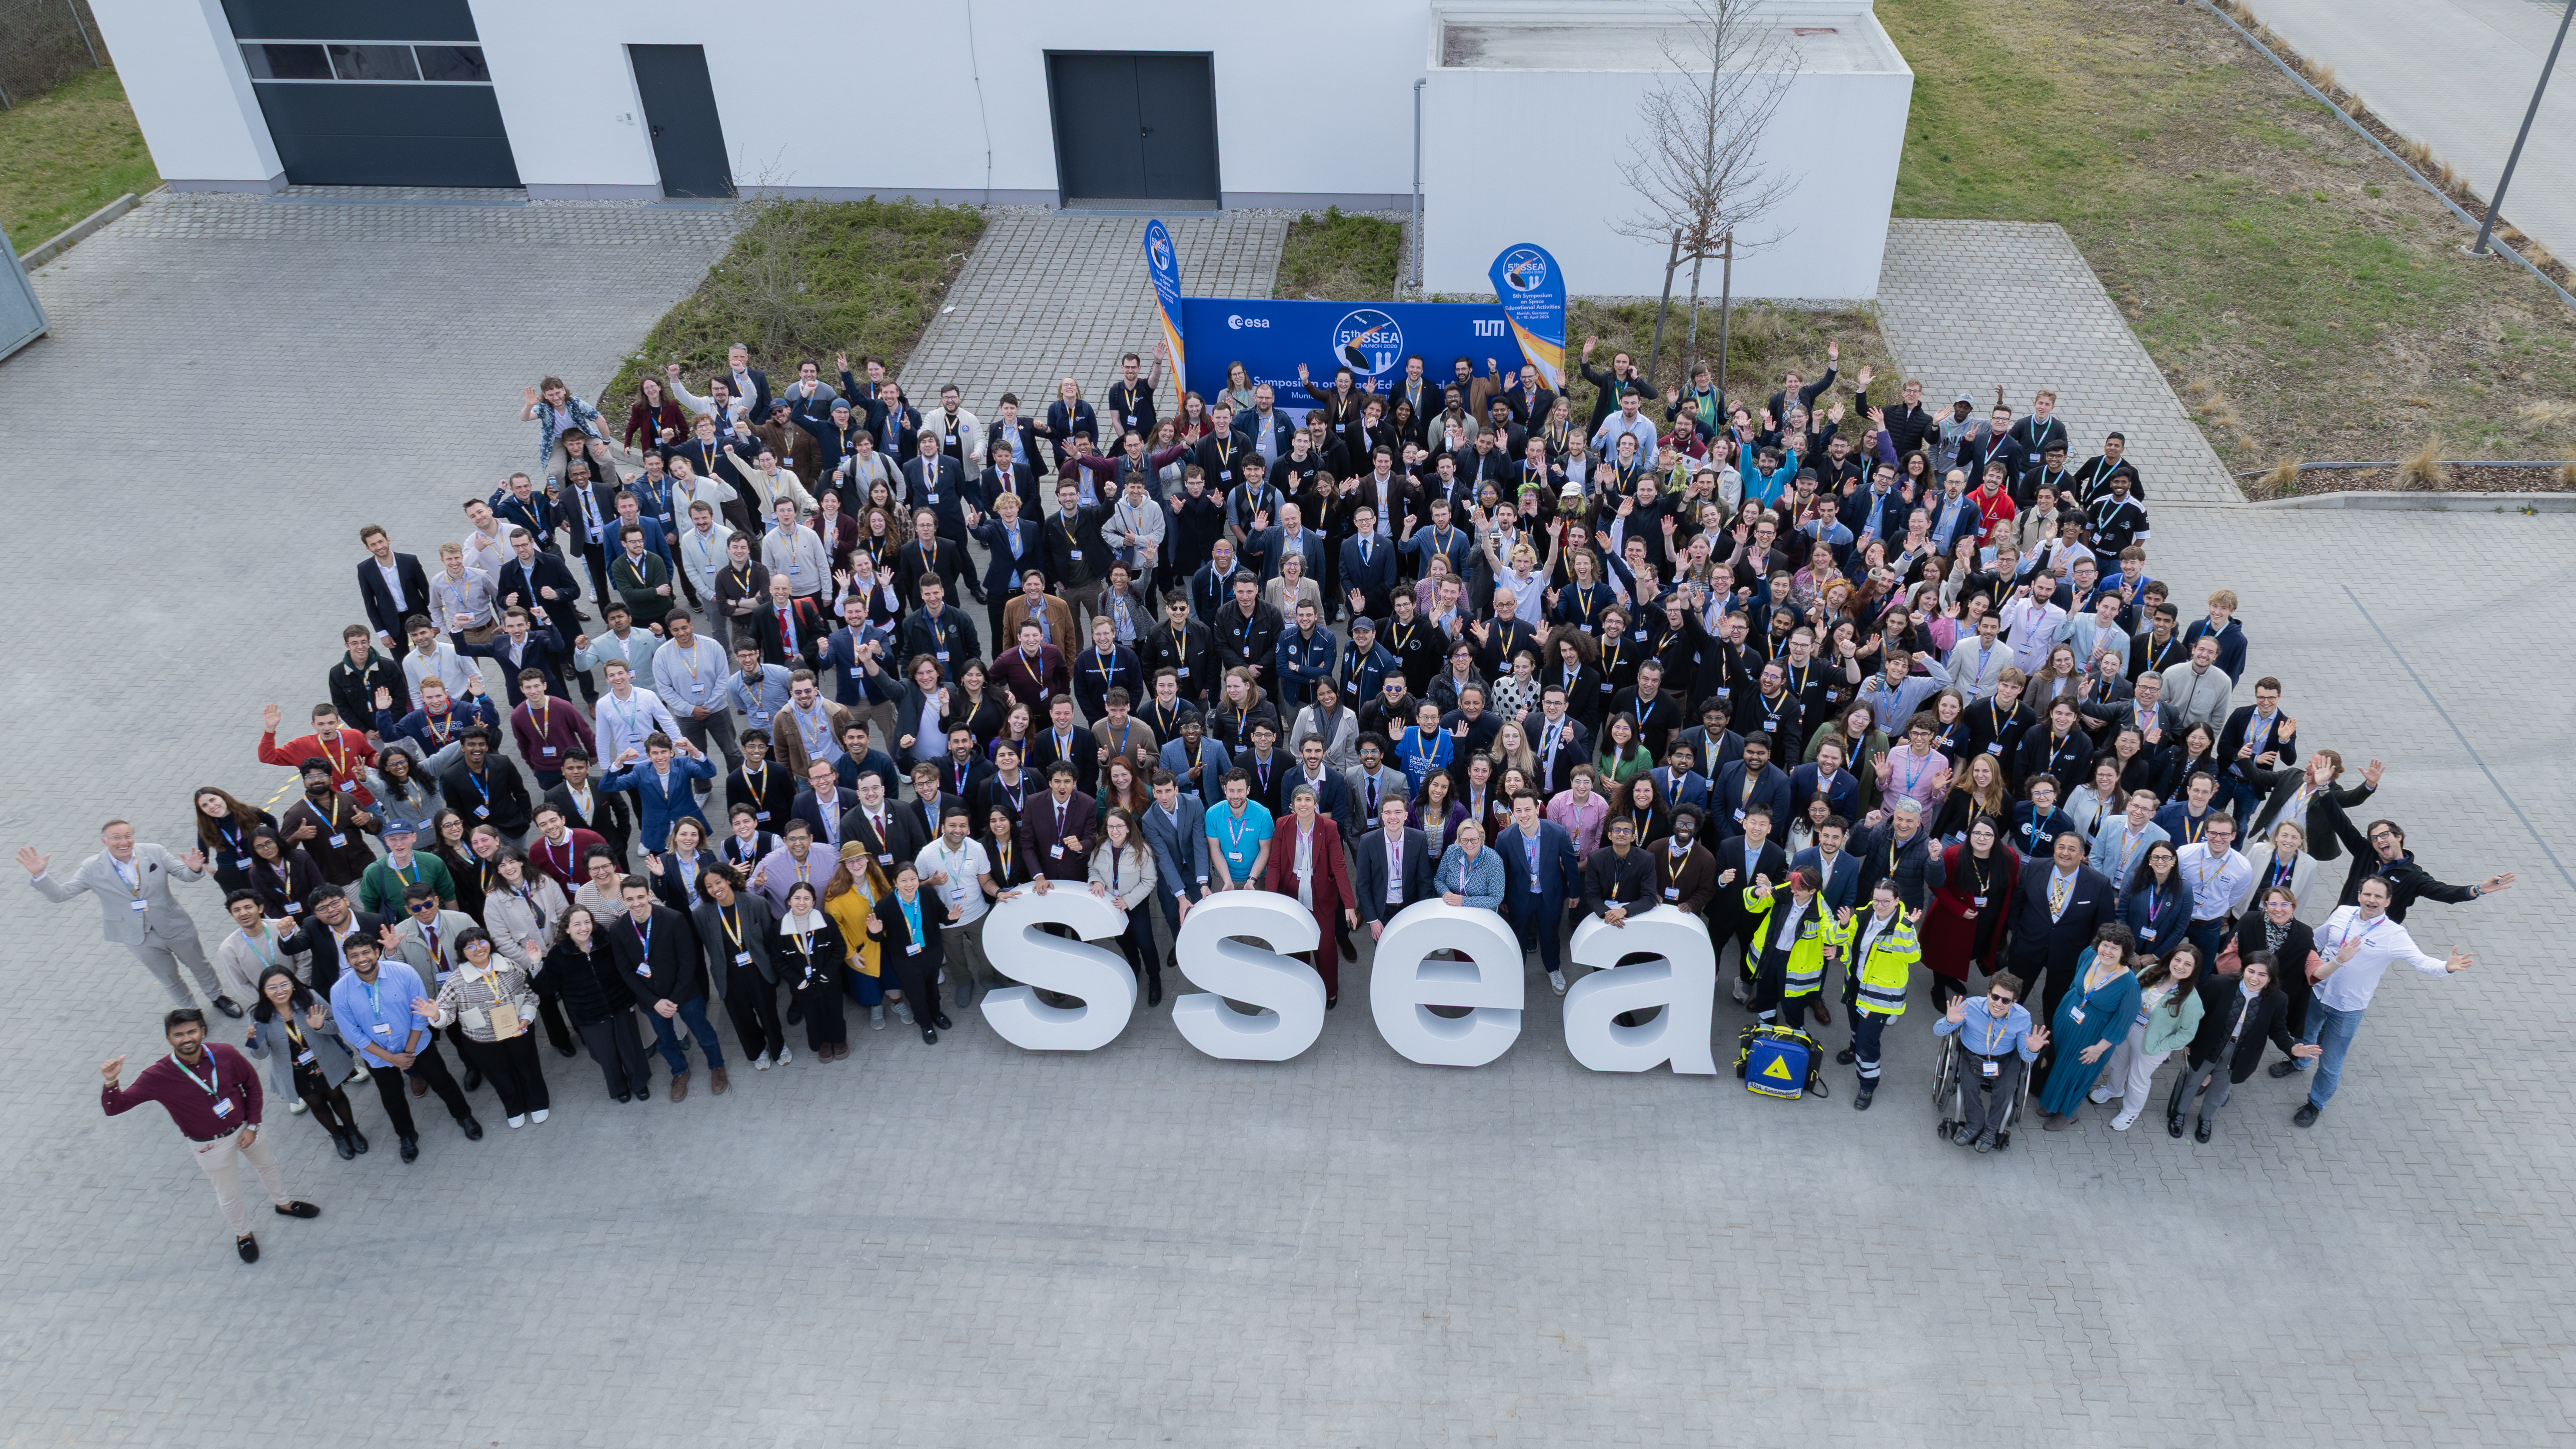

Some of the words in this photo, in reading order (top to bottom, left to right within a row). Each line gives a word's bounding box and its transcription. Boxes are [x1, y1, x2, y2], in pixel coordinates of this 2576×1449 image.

[1508, 262, 1519, 272] 5th
[1473, 320, 1505, 336] TUM
[1341, 330, 1360, 343] 5th
[1361, 332, 1400, 344] SSEA
[1254, 376, 1319, 389] Symposim
[1935, 735, 1954, 747] esa
[1410, 755, 1430, 763] EUROPAN
[1410, 759, 1439, 768] ROCKRY
[2035, 829, 2053, 842] esa
[980, 880, 1717, 1075] ssea
[1750, 1082, 1762, 1091] AStA
